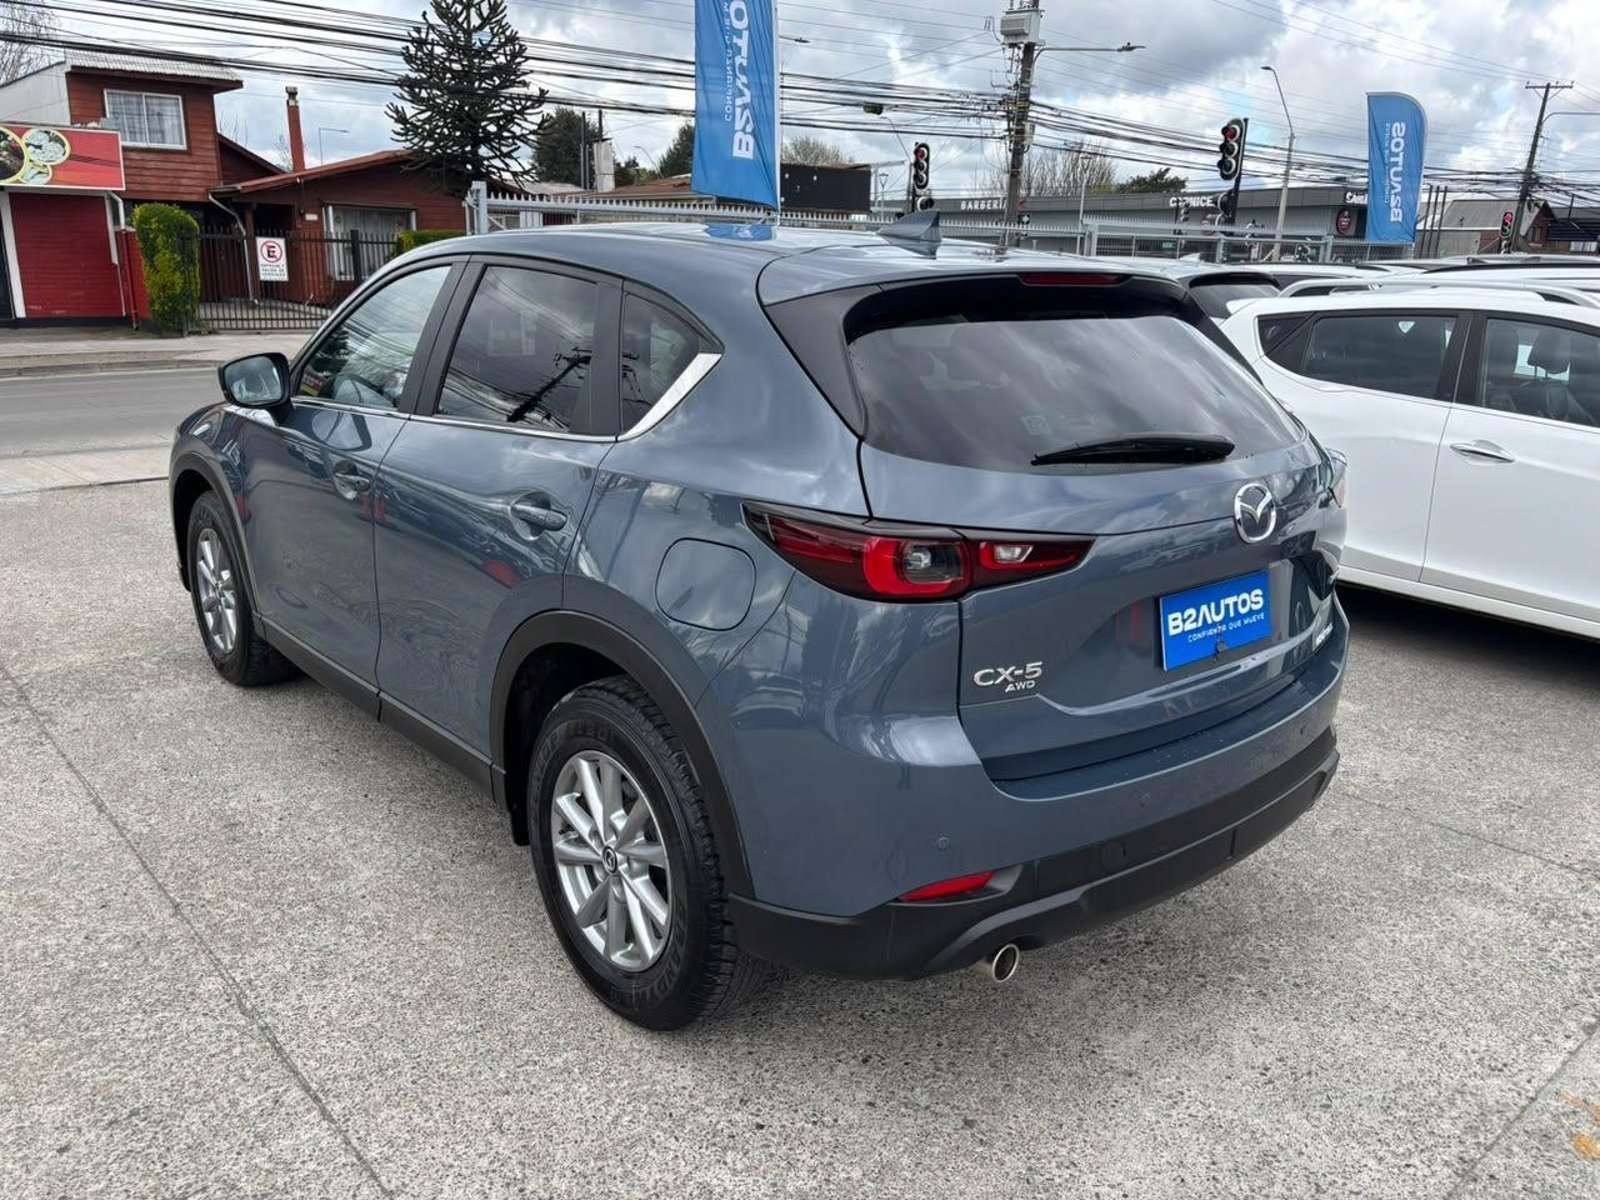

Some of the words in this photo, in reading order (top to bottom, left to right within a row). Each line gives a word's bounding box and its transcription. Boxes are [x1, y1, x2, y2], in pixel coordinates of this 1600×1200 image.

[1167, 588, 1264, 637] B2AUTOS
[973, 661, 1043, 686] CX-5
[1004, 680, 1036, 692] AWD
